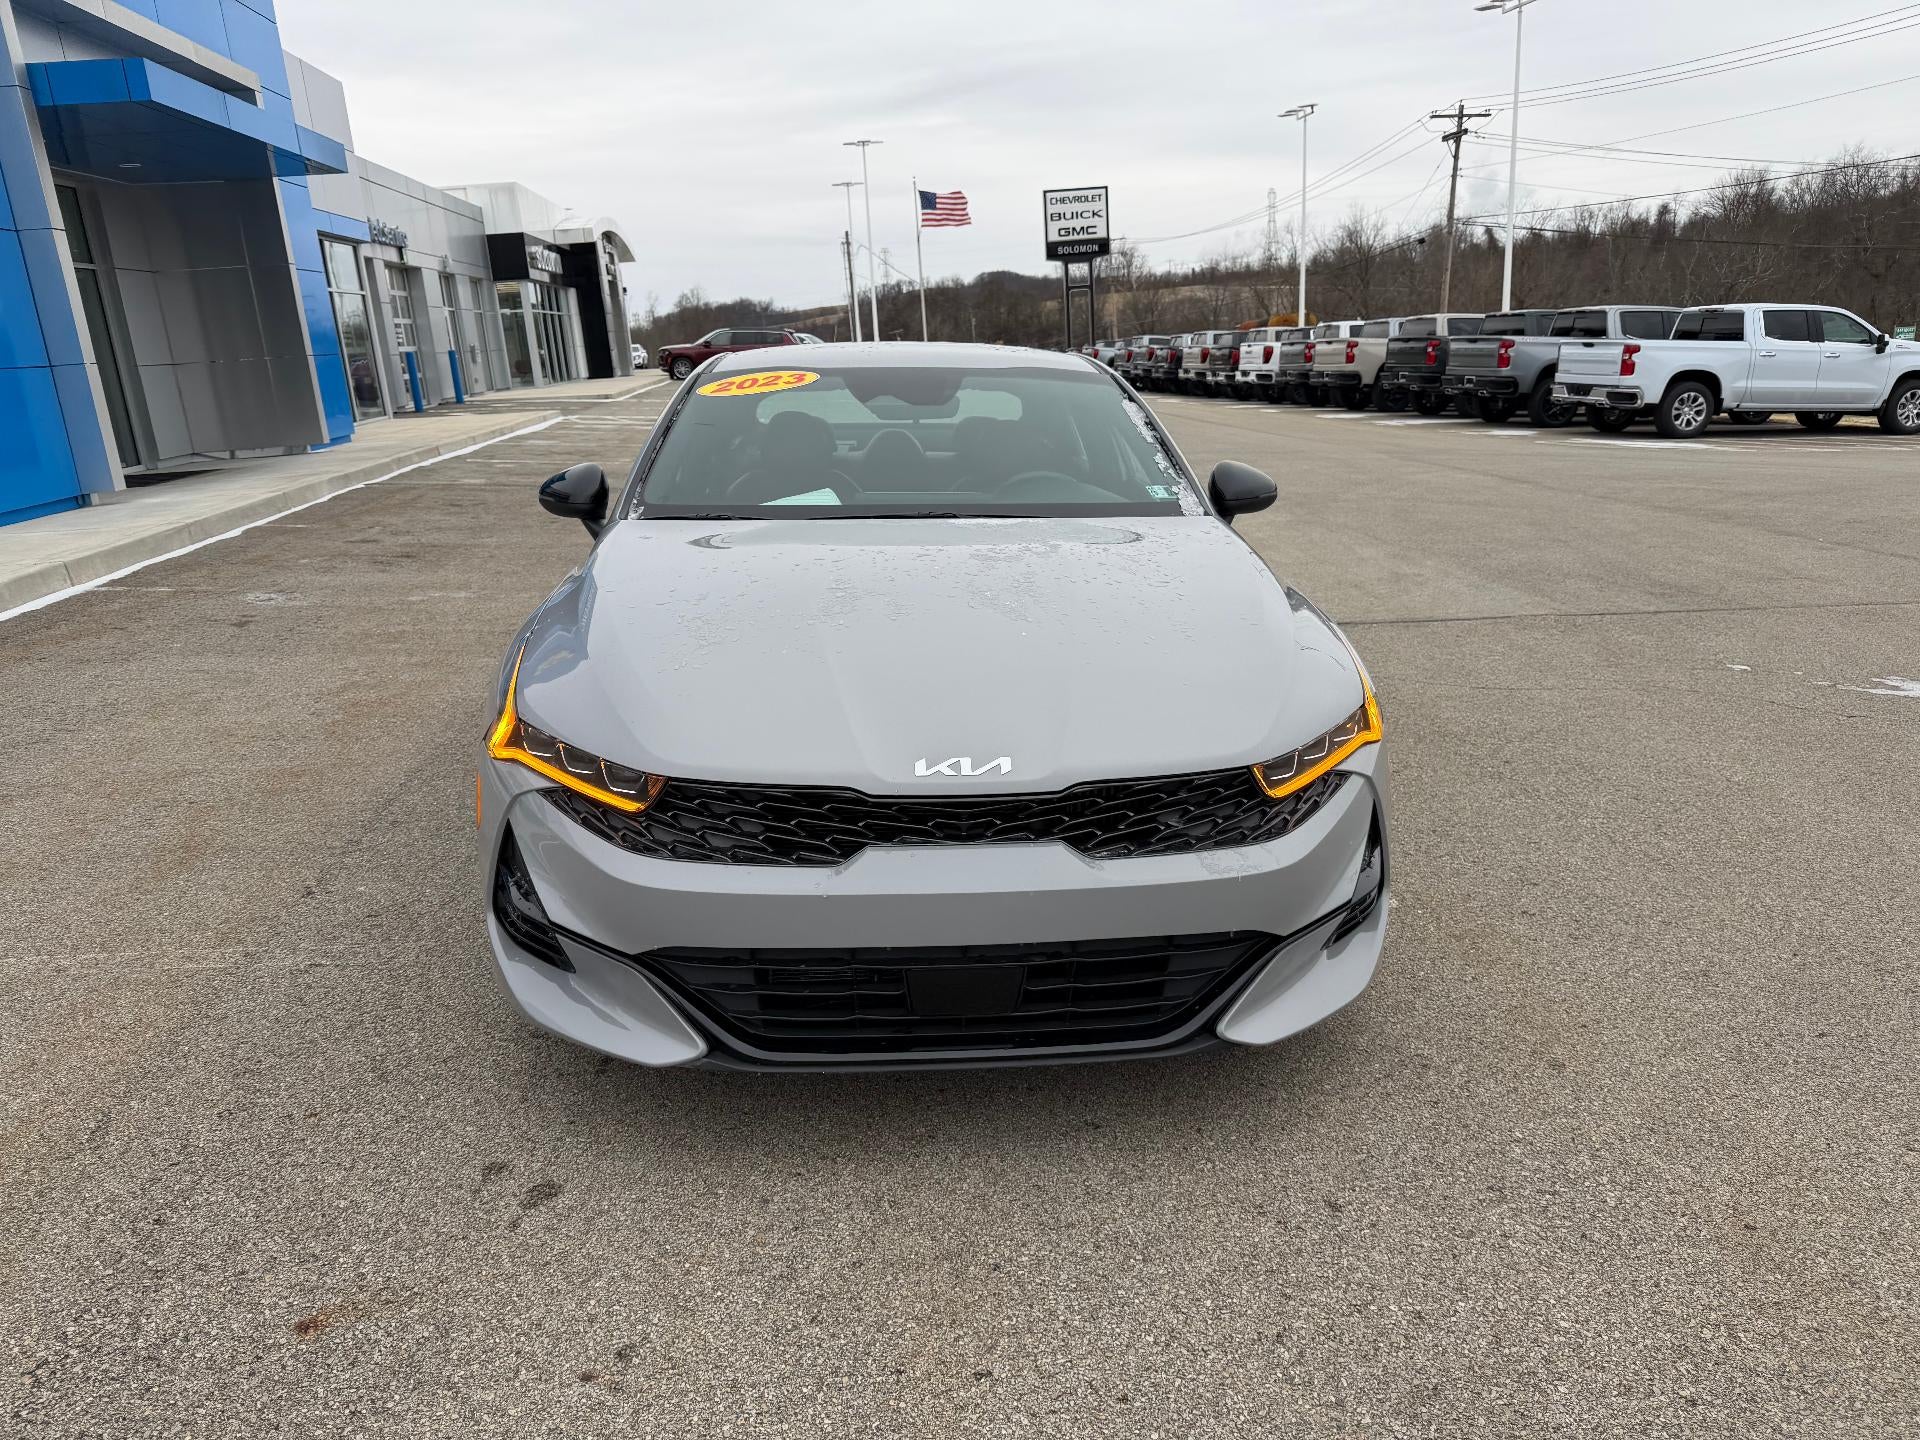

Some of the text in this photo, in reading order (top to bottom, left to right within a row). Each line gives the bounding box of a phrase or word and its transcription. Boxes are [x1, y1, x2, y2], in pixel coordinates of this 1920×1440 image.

[1050, 194, 1103, 205] CHEVROLET
[1050, 210, 1103, 221] BUICK
[1058, 225, 1098, 237] GMC
[1057, 244, 1099, 255] SOLOMON
[710, 373, 807, 394] 2023
